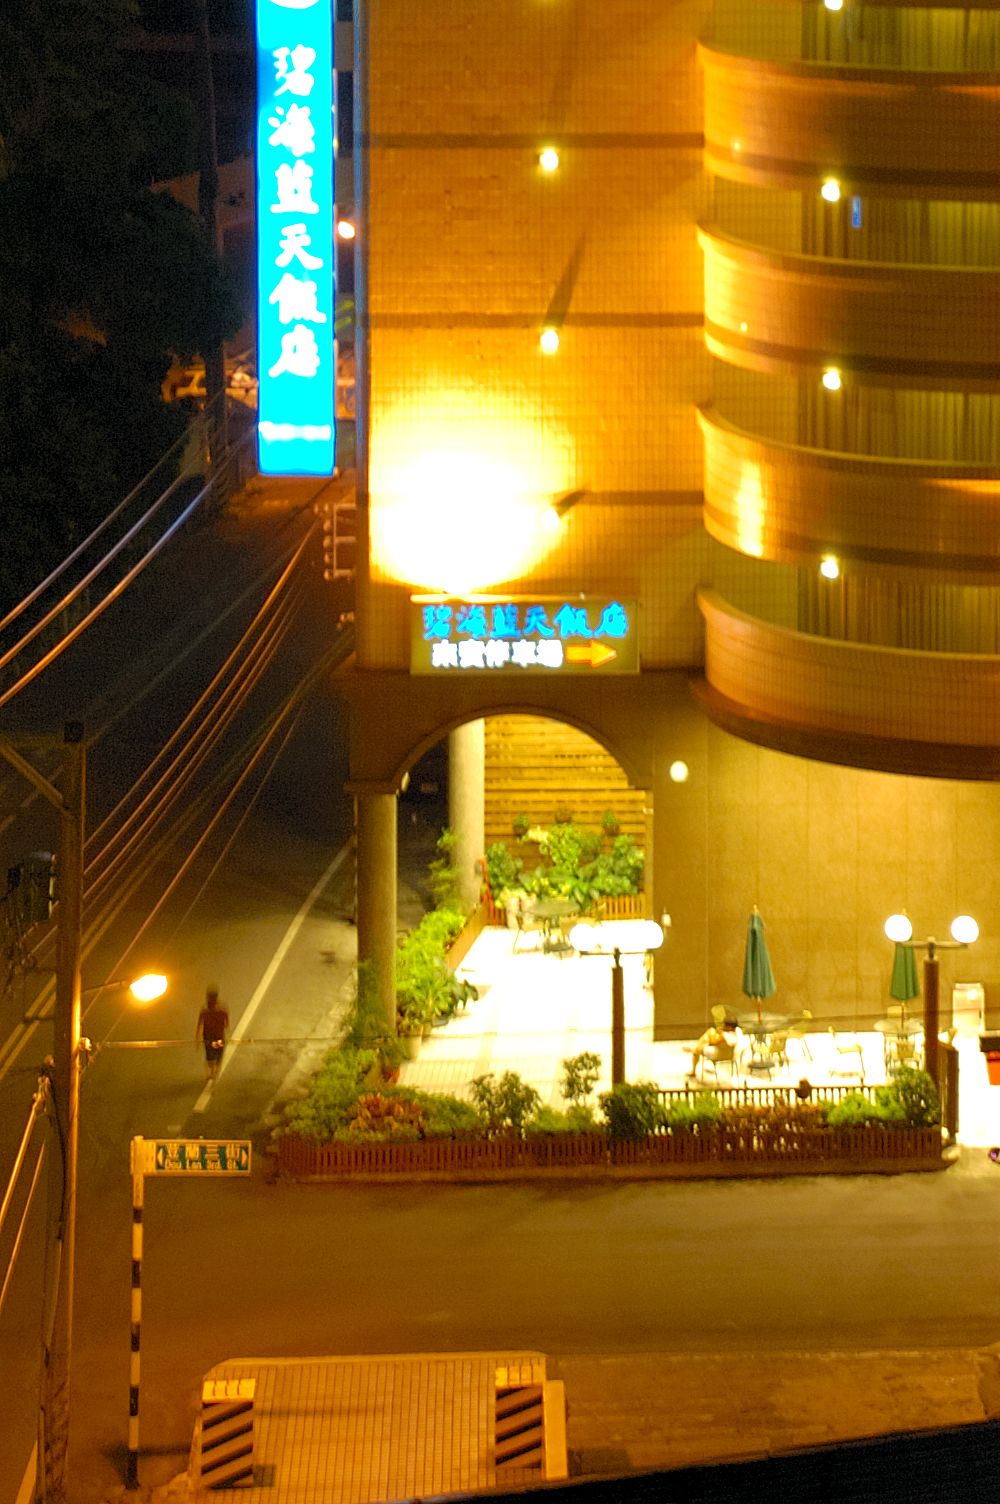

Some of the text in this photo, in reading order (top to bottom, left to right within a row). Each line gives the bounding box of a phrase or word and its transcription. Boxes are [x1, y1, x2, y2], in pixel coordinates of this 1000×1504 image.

[268, 44, 327, 378] 碧海藍天飯店
